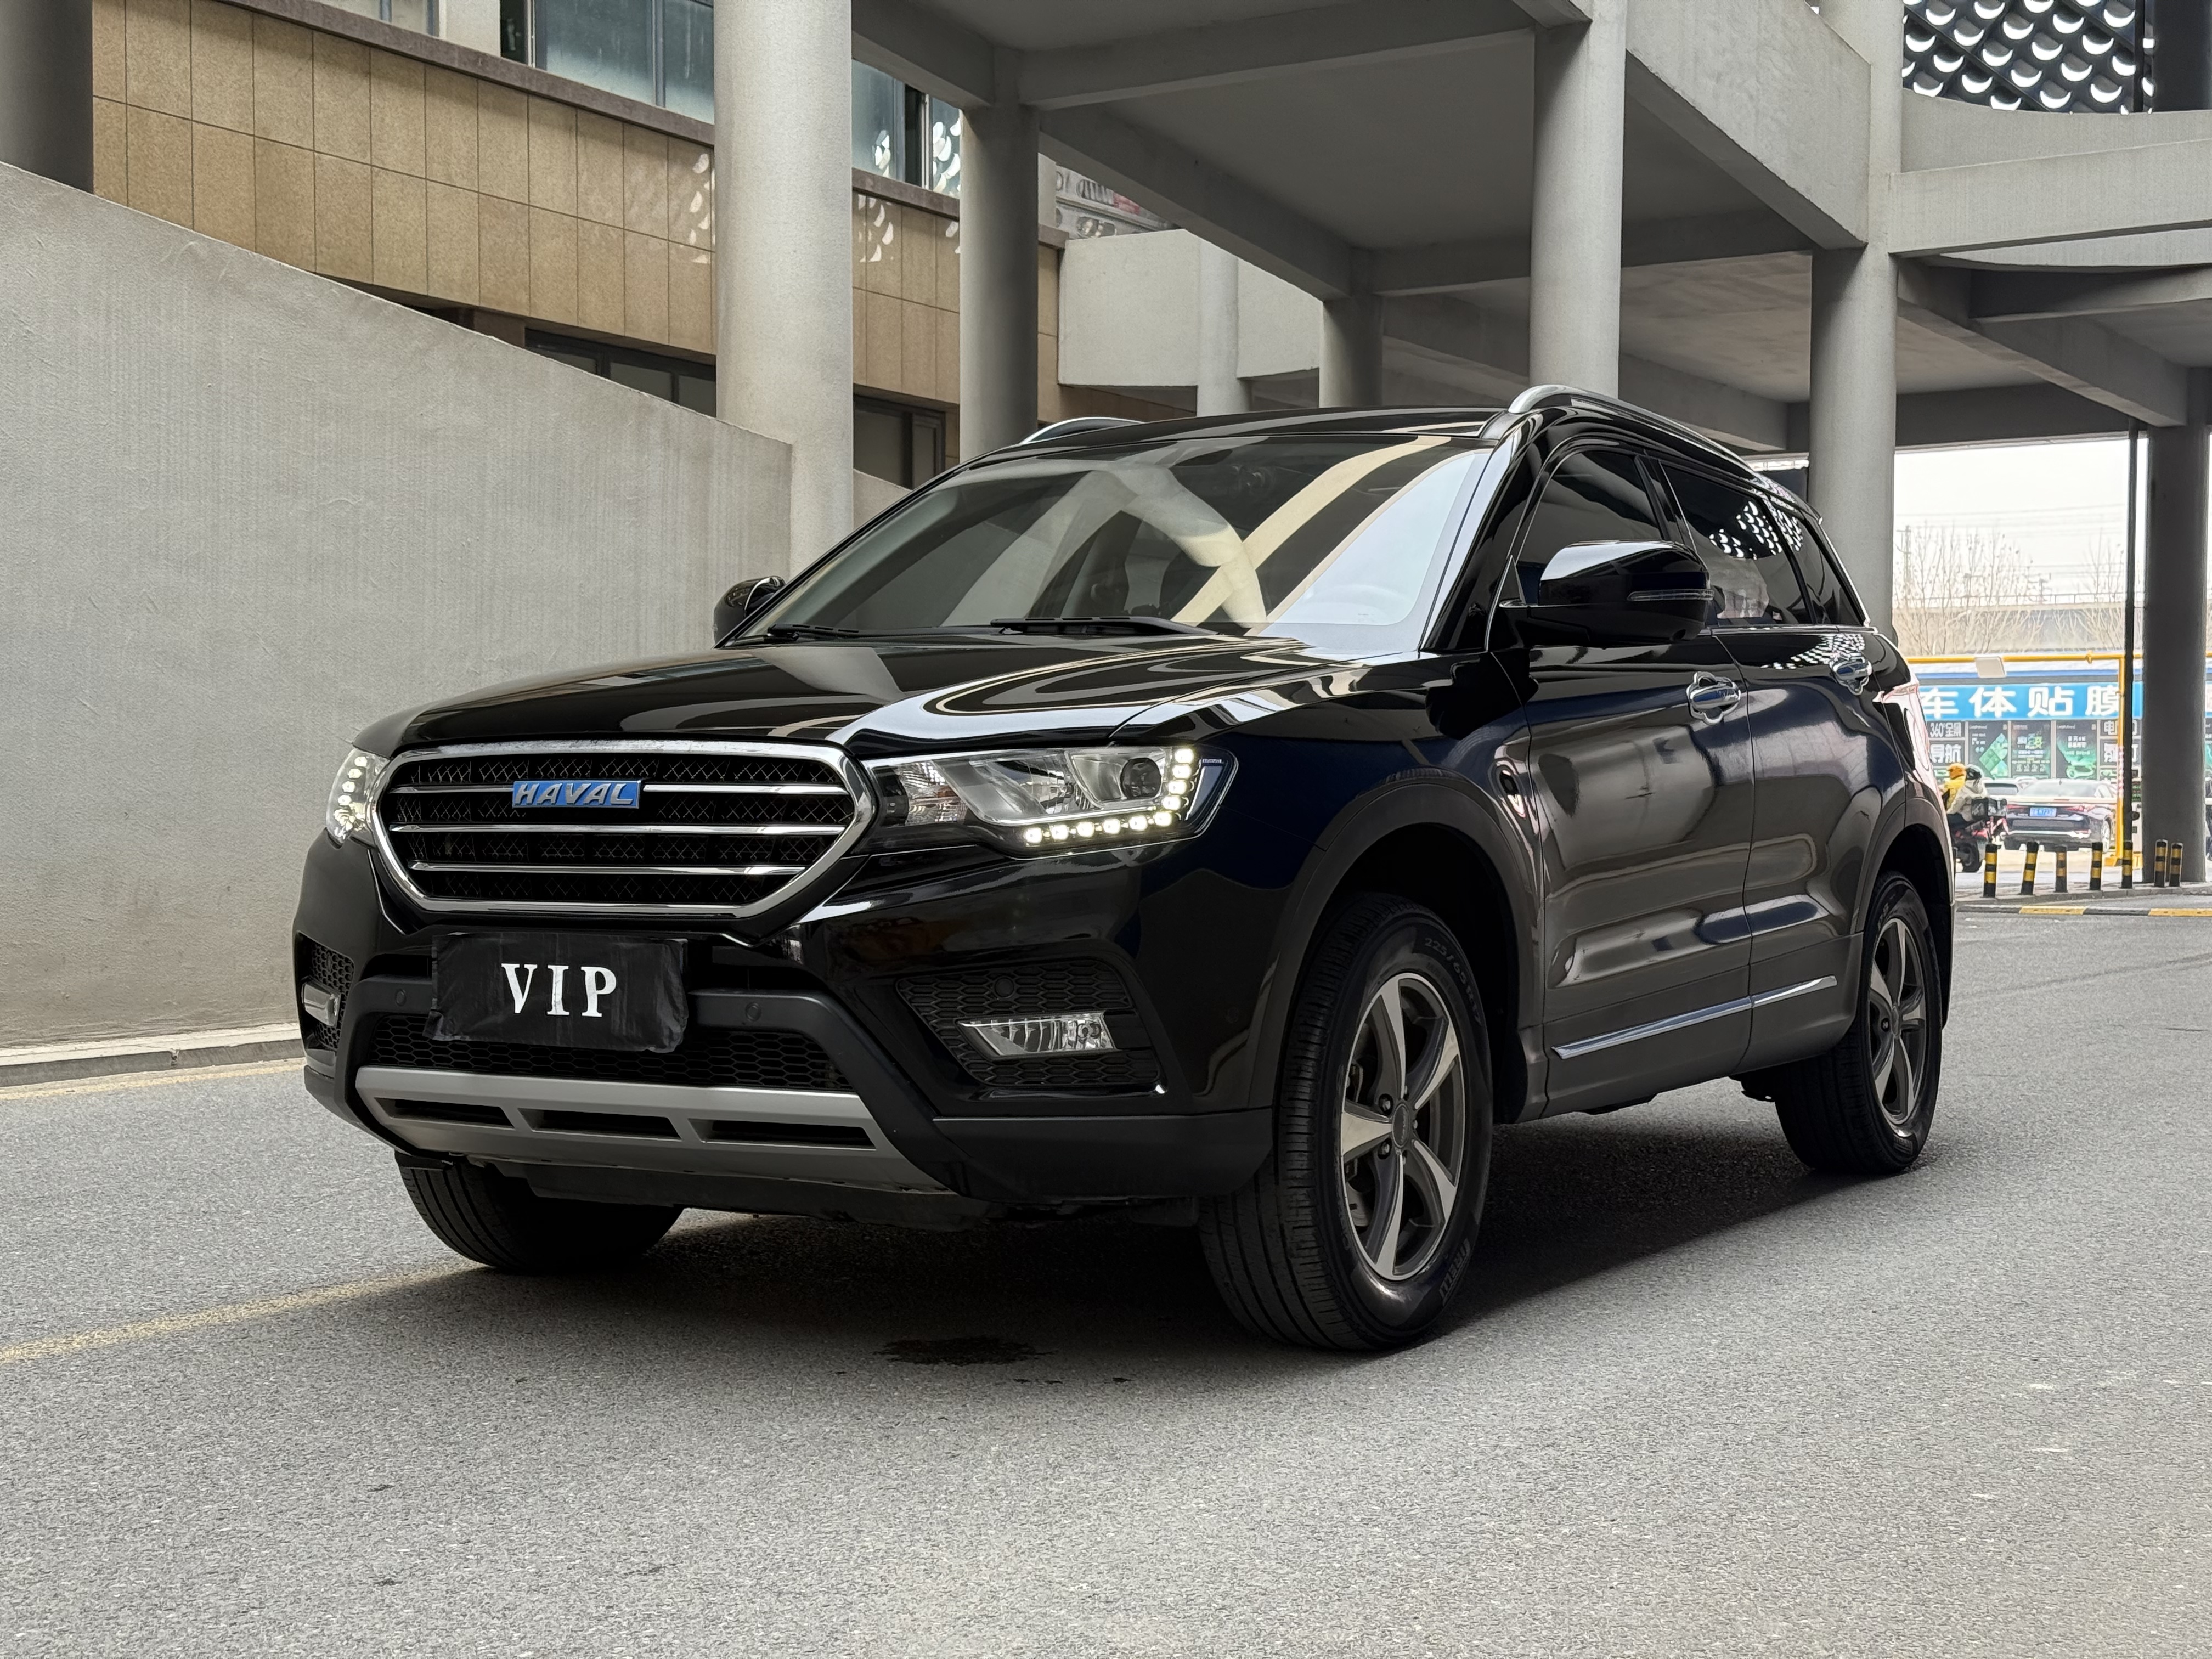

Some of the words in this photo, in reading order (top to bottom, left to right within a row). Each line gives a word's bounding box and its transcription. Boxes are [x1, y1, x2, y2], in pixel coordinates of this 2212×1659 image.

[1929, 743, 1962, 764] 导航
[514, 783, 634, 805] HAVAL
[501, 963, 616, 1017] VIP
[1438, 1237, 1471, 1307] PIRELLI
